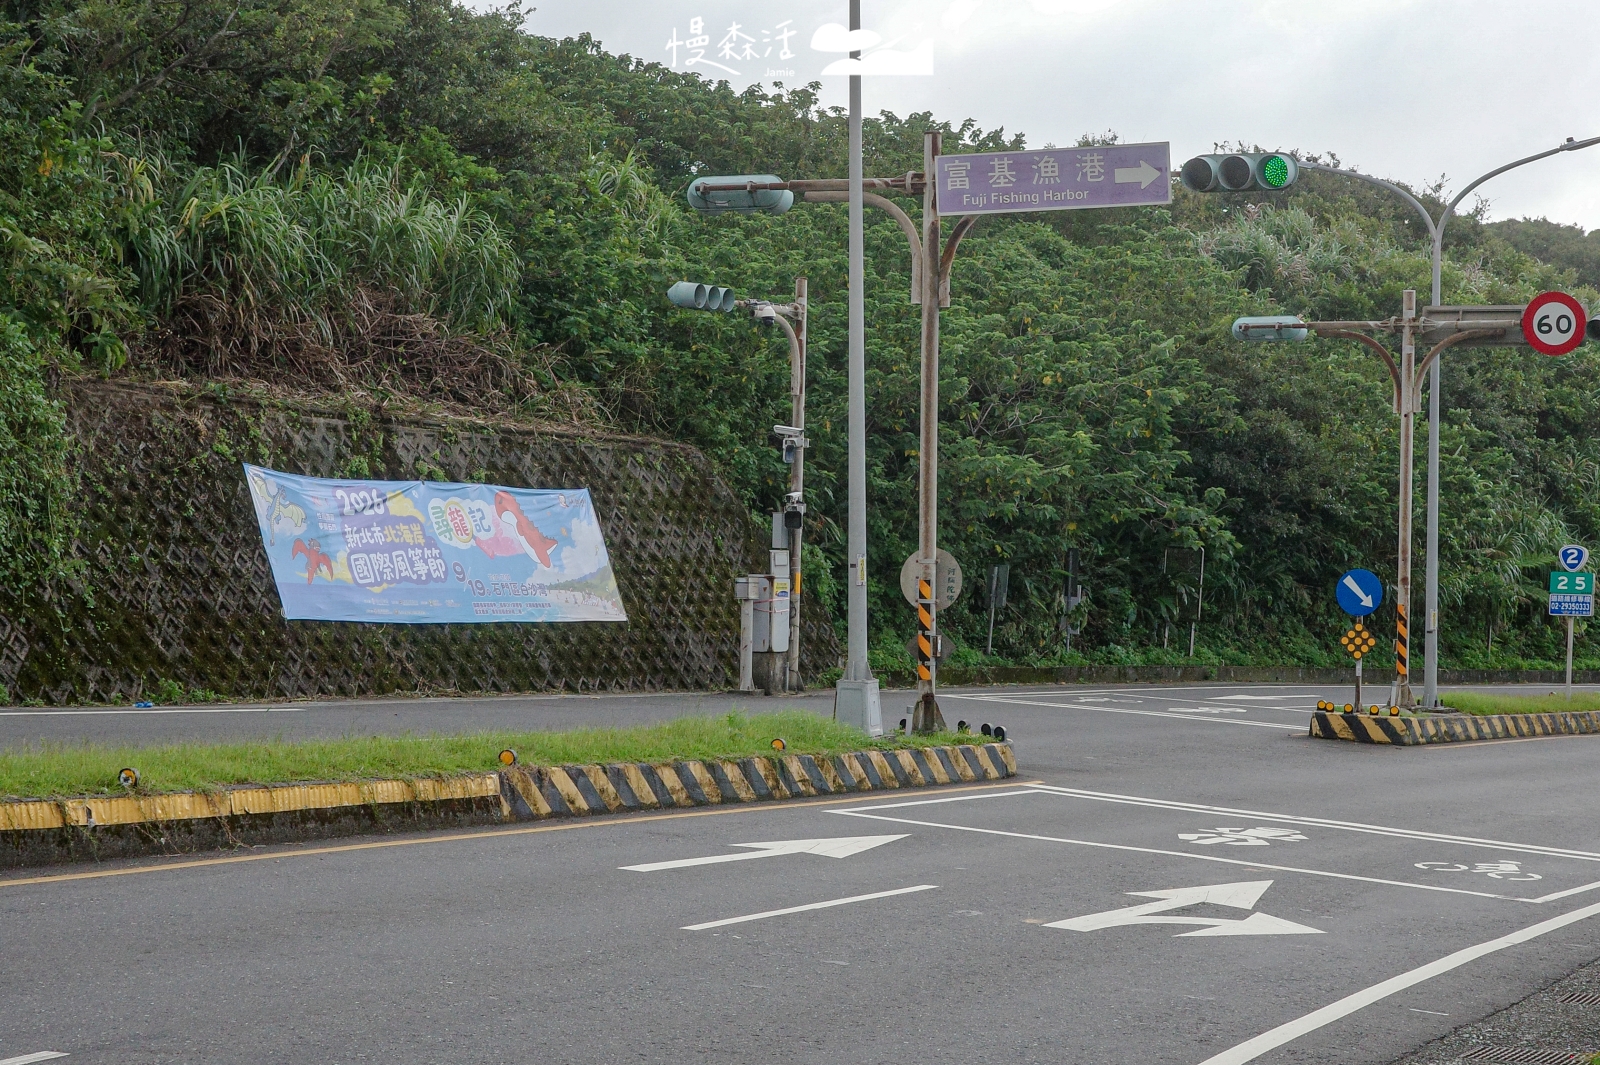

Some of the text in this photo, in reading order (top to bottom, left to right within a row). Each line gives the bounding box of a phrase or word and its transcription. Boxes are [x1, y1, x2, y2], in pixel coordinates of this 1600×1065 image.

[944, 152, 1106, 191] 富基漁港
[963, 188, 1089, 208] Fuji Fishing Harbor
[1537, 314, 1572, 335] 60
[344, 521, 426, 549] 新北市北海岸
[430, 505, 492, 541] 尋龍記
[350, 547, 446, 584] 國際風箏節
[1566, 548, 1579, 564] 2
